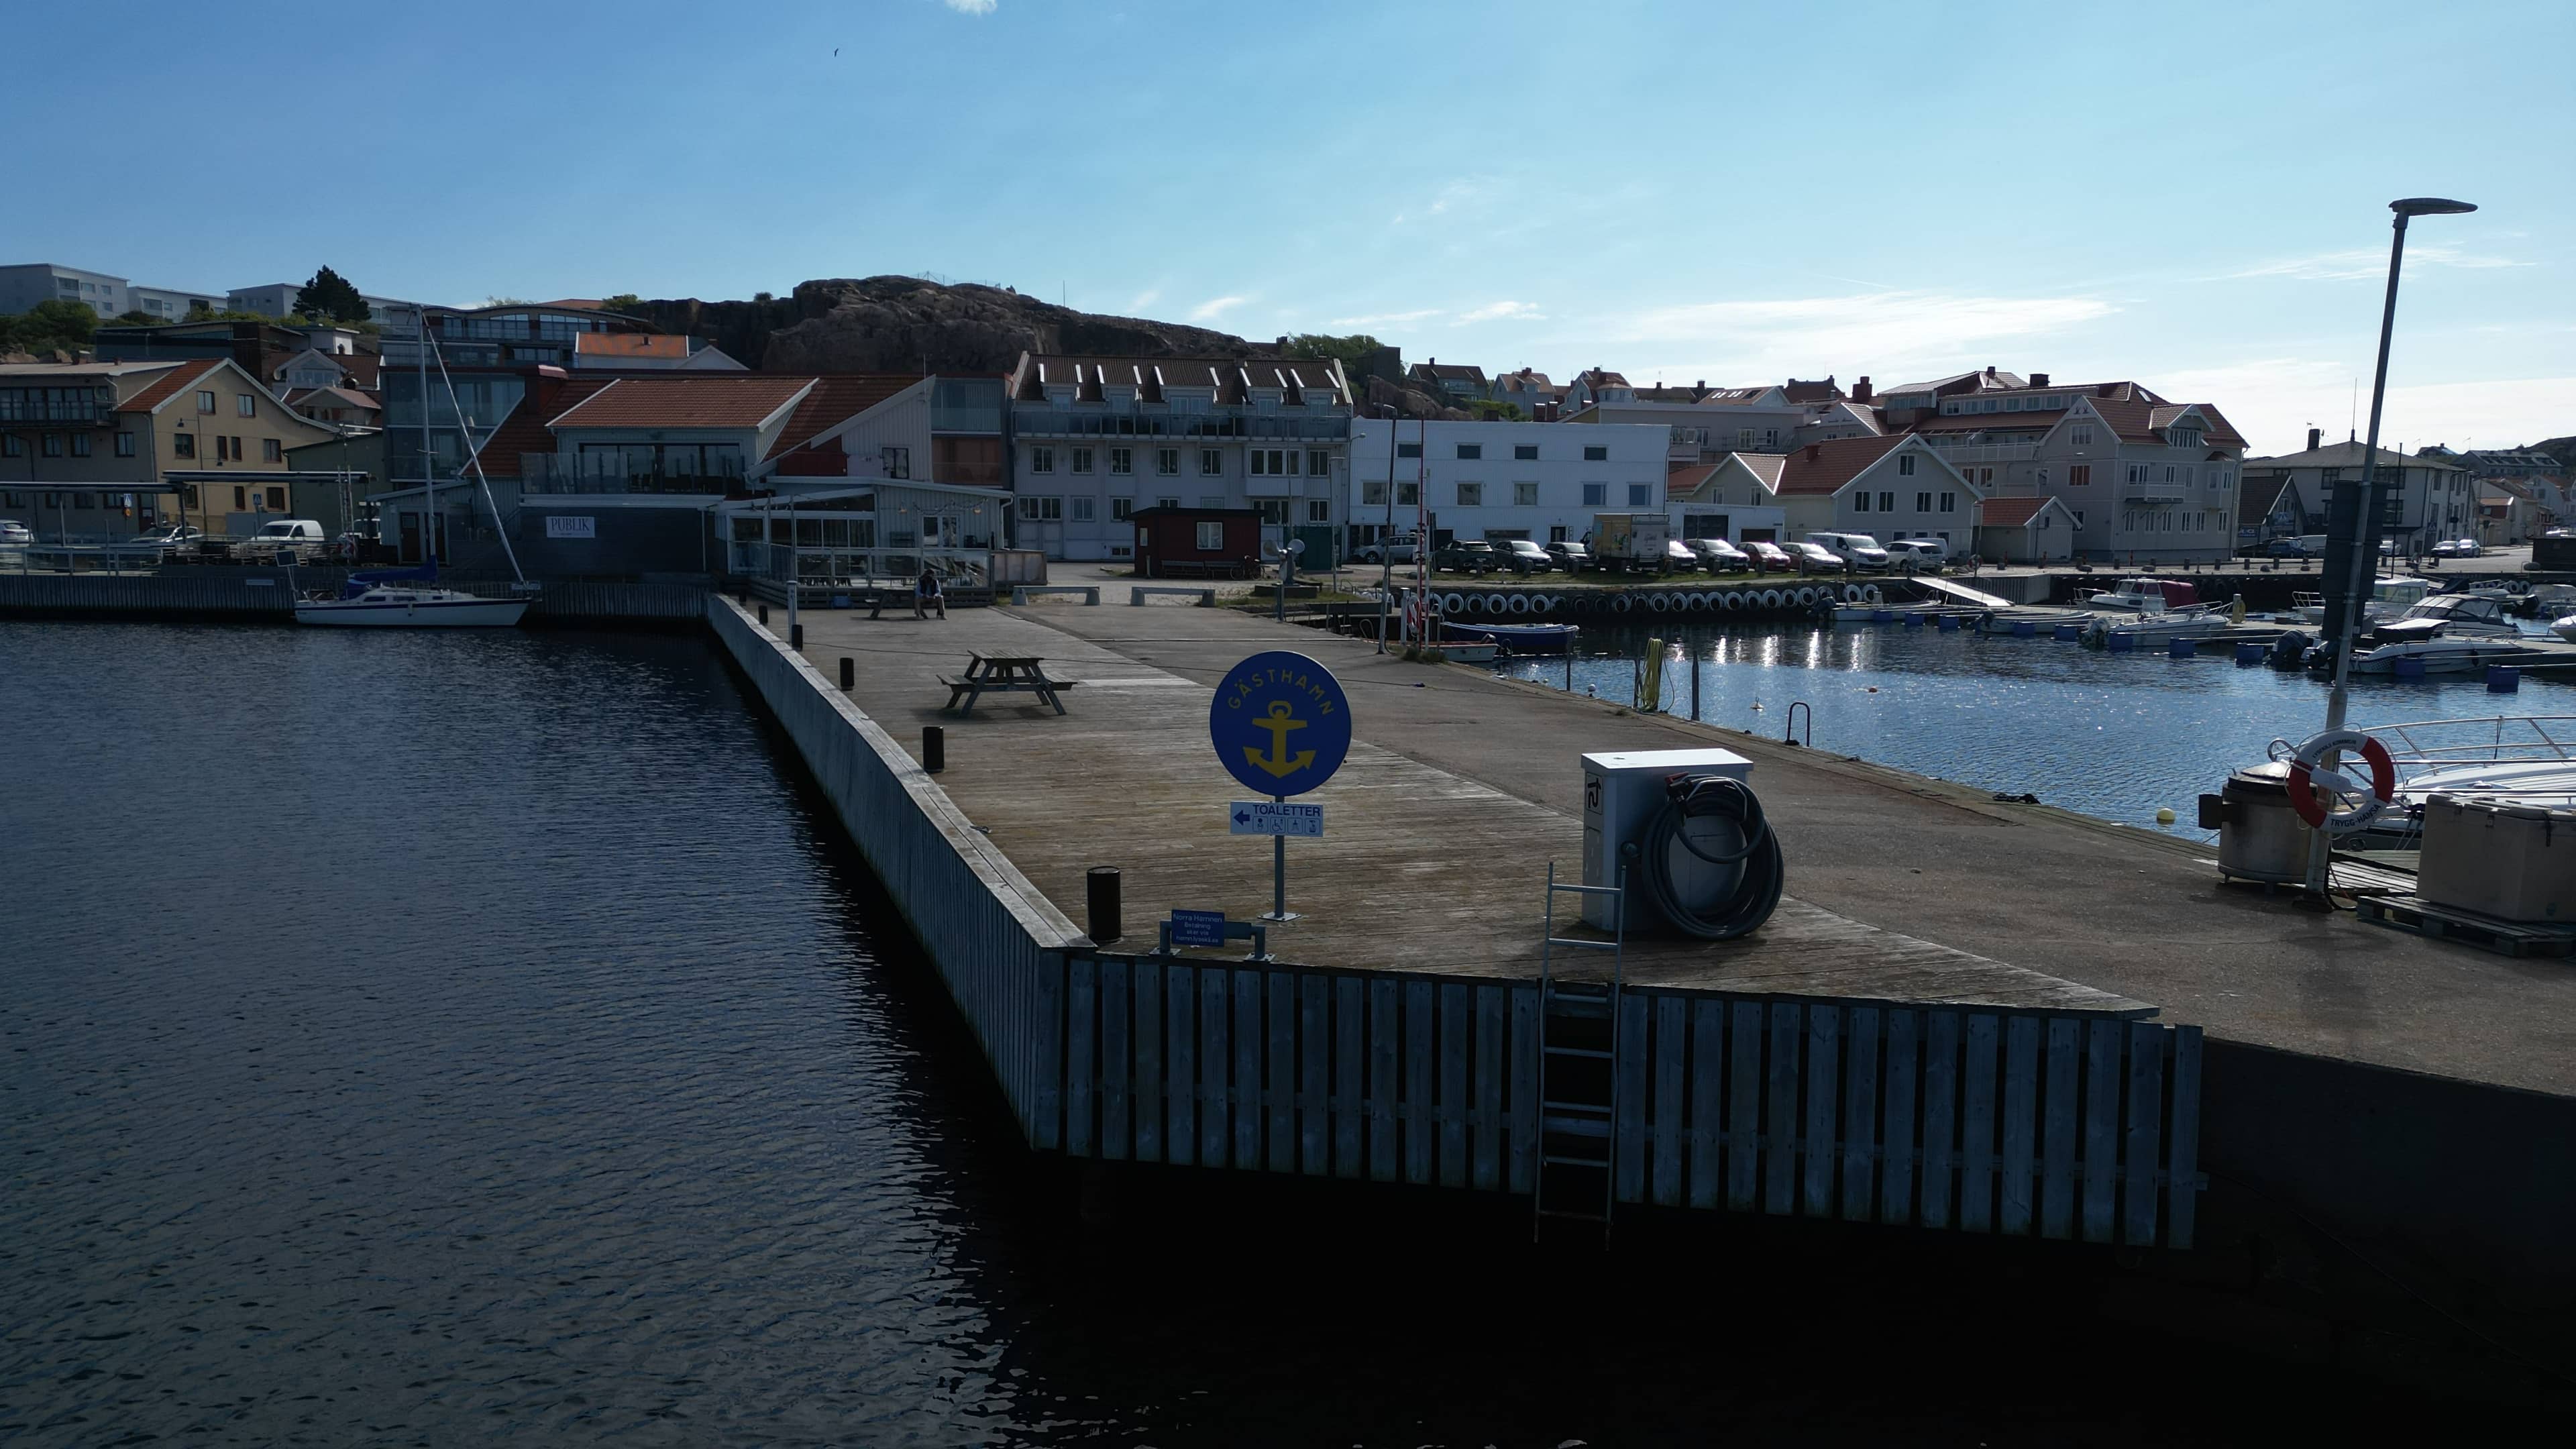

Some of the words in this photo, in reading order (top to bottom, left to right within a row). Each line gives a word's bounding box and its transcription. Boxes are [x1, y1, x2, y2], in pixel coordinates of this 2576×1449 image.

[551, 517, 590, 531] PUBLIK
[1228, 669, 1334, 715] GÄSTHAMN
[1252, 804, 1320, 816] TOALETTER
[2330, 804, 2381, 827] TRYGG-HANSA
